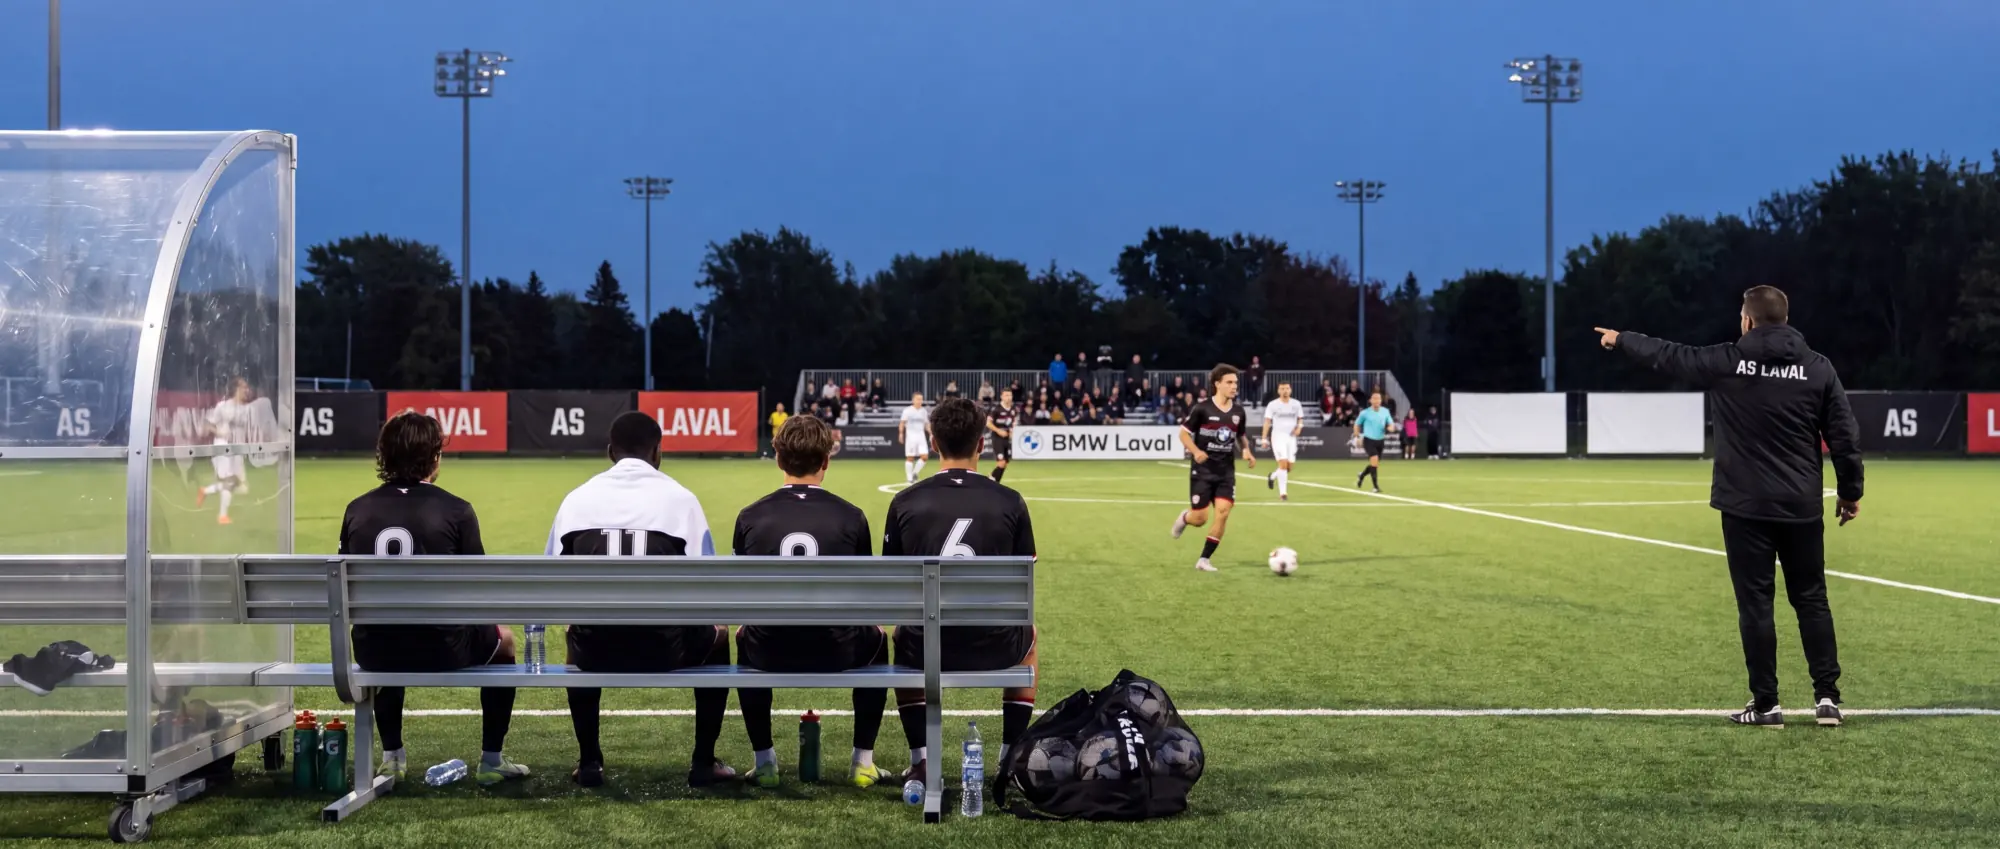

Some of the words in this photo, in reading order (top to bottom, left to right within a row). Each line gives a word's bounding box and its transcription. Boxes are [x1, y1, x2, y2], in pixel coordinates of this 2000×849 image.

[1735, 359, 1757, 376] AS
[1760, 364, 1808, 381] LAVAL
[56, 407, 91, 437] AS
[299, 407, 334, 436] AS
[550, 407, 585, 436] AS
[657, 407, 737, 436] LAVAL
[1883, 408, 1918, 438] AS
[1052, 433, 1108, 452] BMW
[1115, 433, 1172, 452] Laval
[325, 739, 339, 756] G
